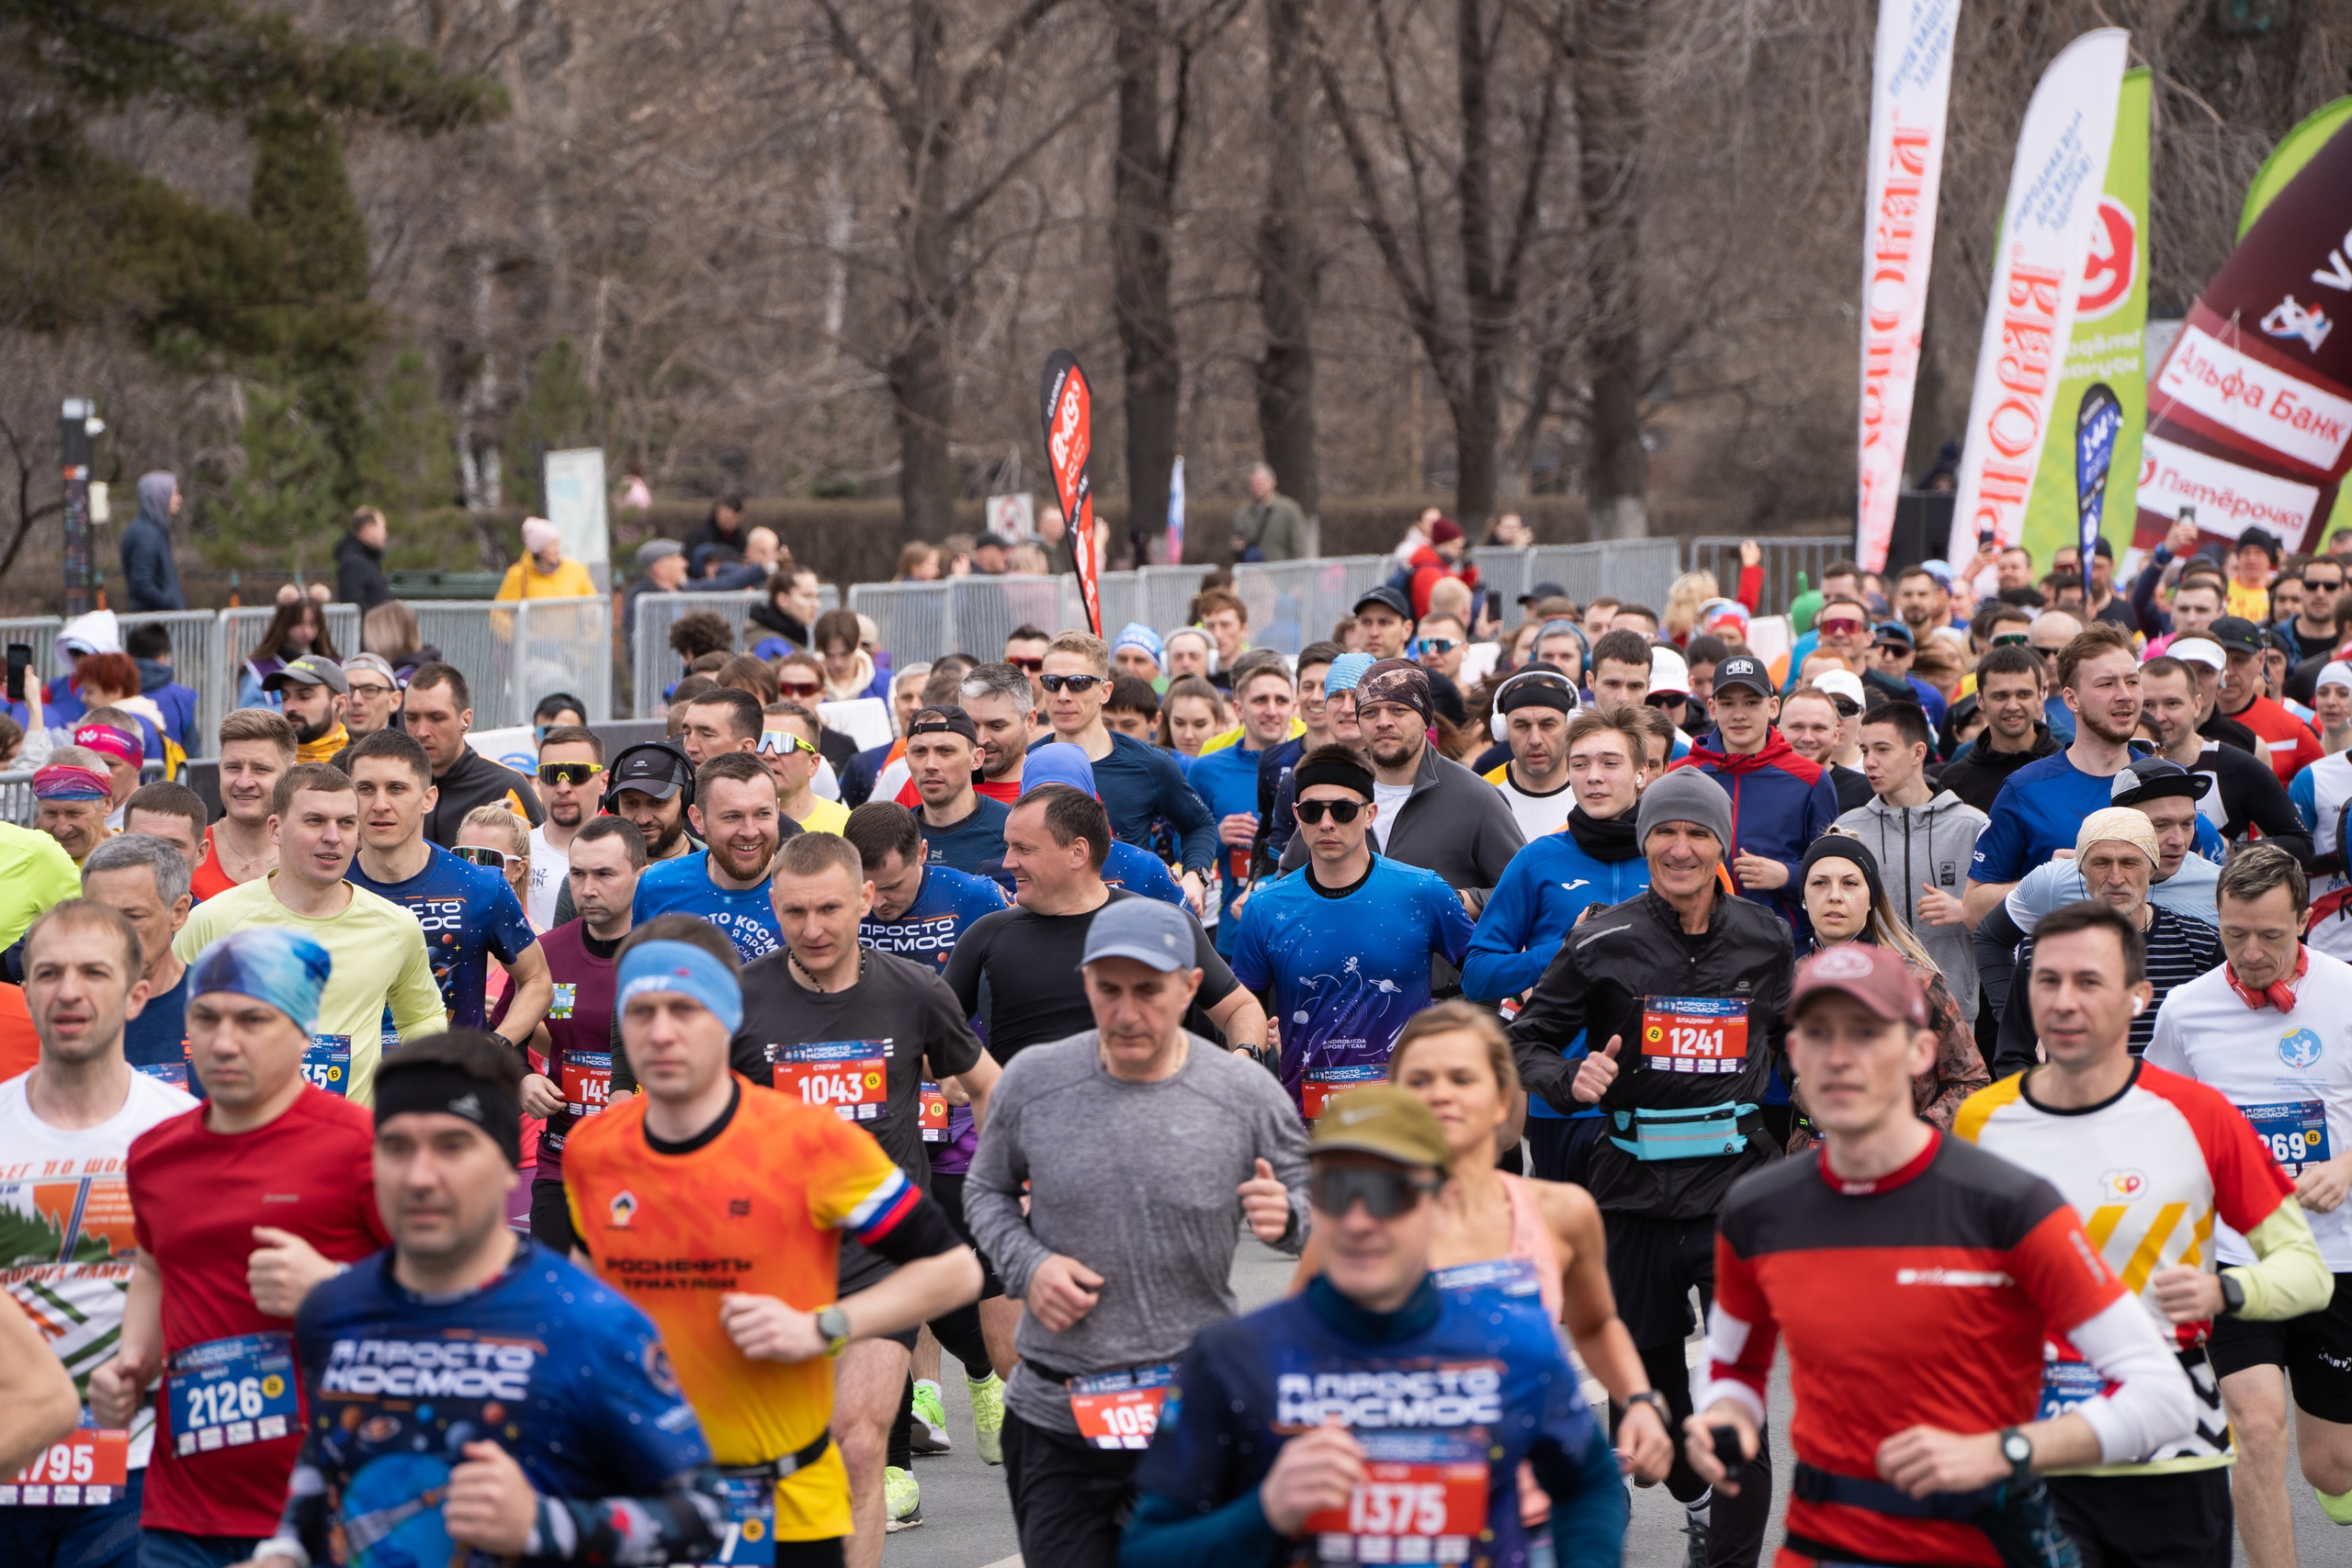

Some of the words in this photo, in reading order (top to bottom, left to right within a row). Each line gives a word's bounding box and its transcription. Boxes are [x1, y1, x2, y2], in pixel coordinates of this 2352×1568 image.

[1047, 368, 1066, 418] GARMIN
[2174, 341, 2264, 408] Альфа
[2267, 389, 2346, 445] Банк
[2159, 467, 2305, 531] Пятёрочка
[858, 918, 955, 937] ПРОСТО
[807, 1051, 851, 1059] КОСМОС
[813, 1045, 851, 1054] ПРОСТО
[1670, 1028, 1724, 1055] 1241
[813, 1063, 841, 1071] СТЕПАН
[798, 1073, 863, 1105] 1043
[0, 1161, 33, 1179] ЕГ
[43, 1158, 75, 1177] ПО
[356, 1339, 536, 1371] ПРОСТО
[322, 1364, 531, 1401] КОСМОС
[1313, 1367, 1500, 1399] ПРОСТО
[187, 1376, 264, 1428] 2126
[1277, 1393, 1503, 1427] КОСМОС
[1101, 1404, 1163, 1435] 105
[1348, 1481, 1448, 1535] 1375
